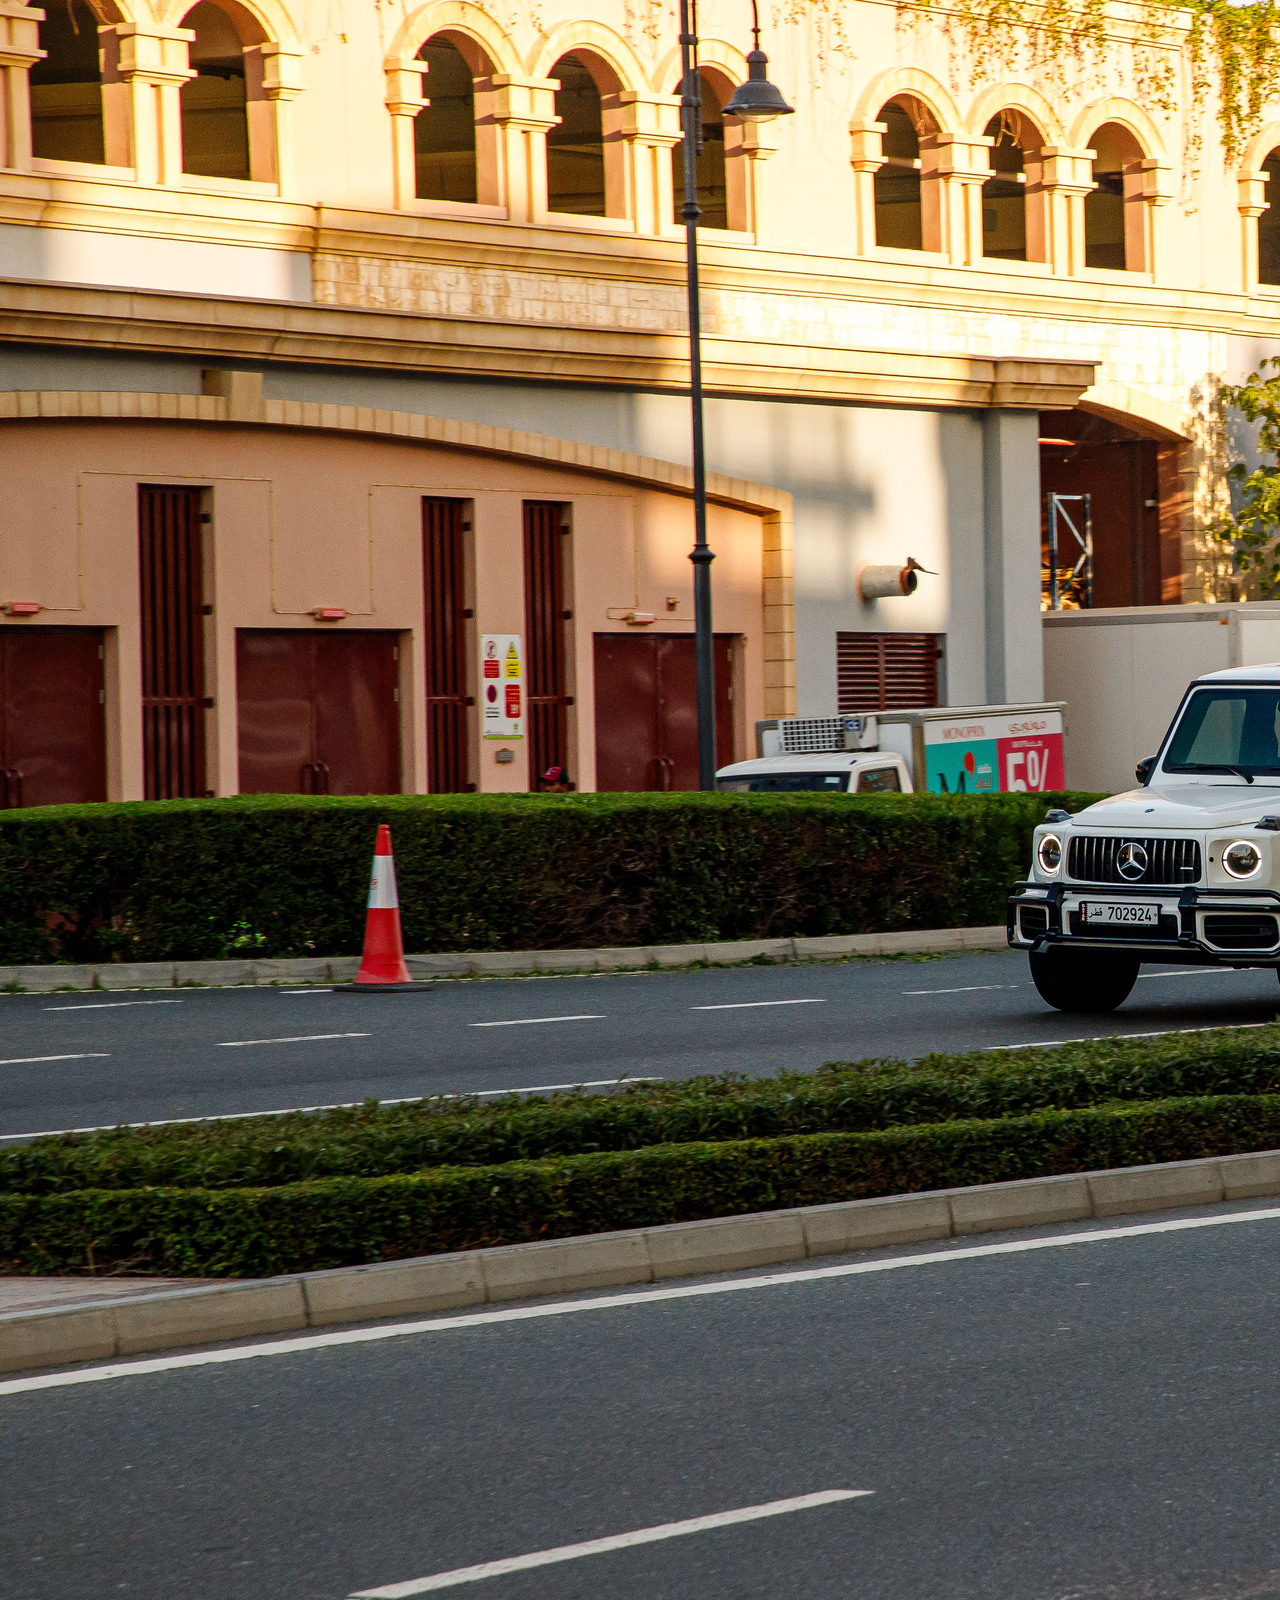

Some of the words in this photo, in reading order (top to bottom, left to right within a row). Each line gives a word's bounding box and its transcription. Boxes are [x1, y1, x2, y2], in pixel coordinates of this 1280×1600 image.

[942, 725, 986, 740] MONOPRIX
[1089, 907, 1103, 918] قطر
[1108, 906, 1152, 922] 702924
